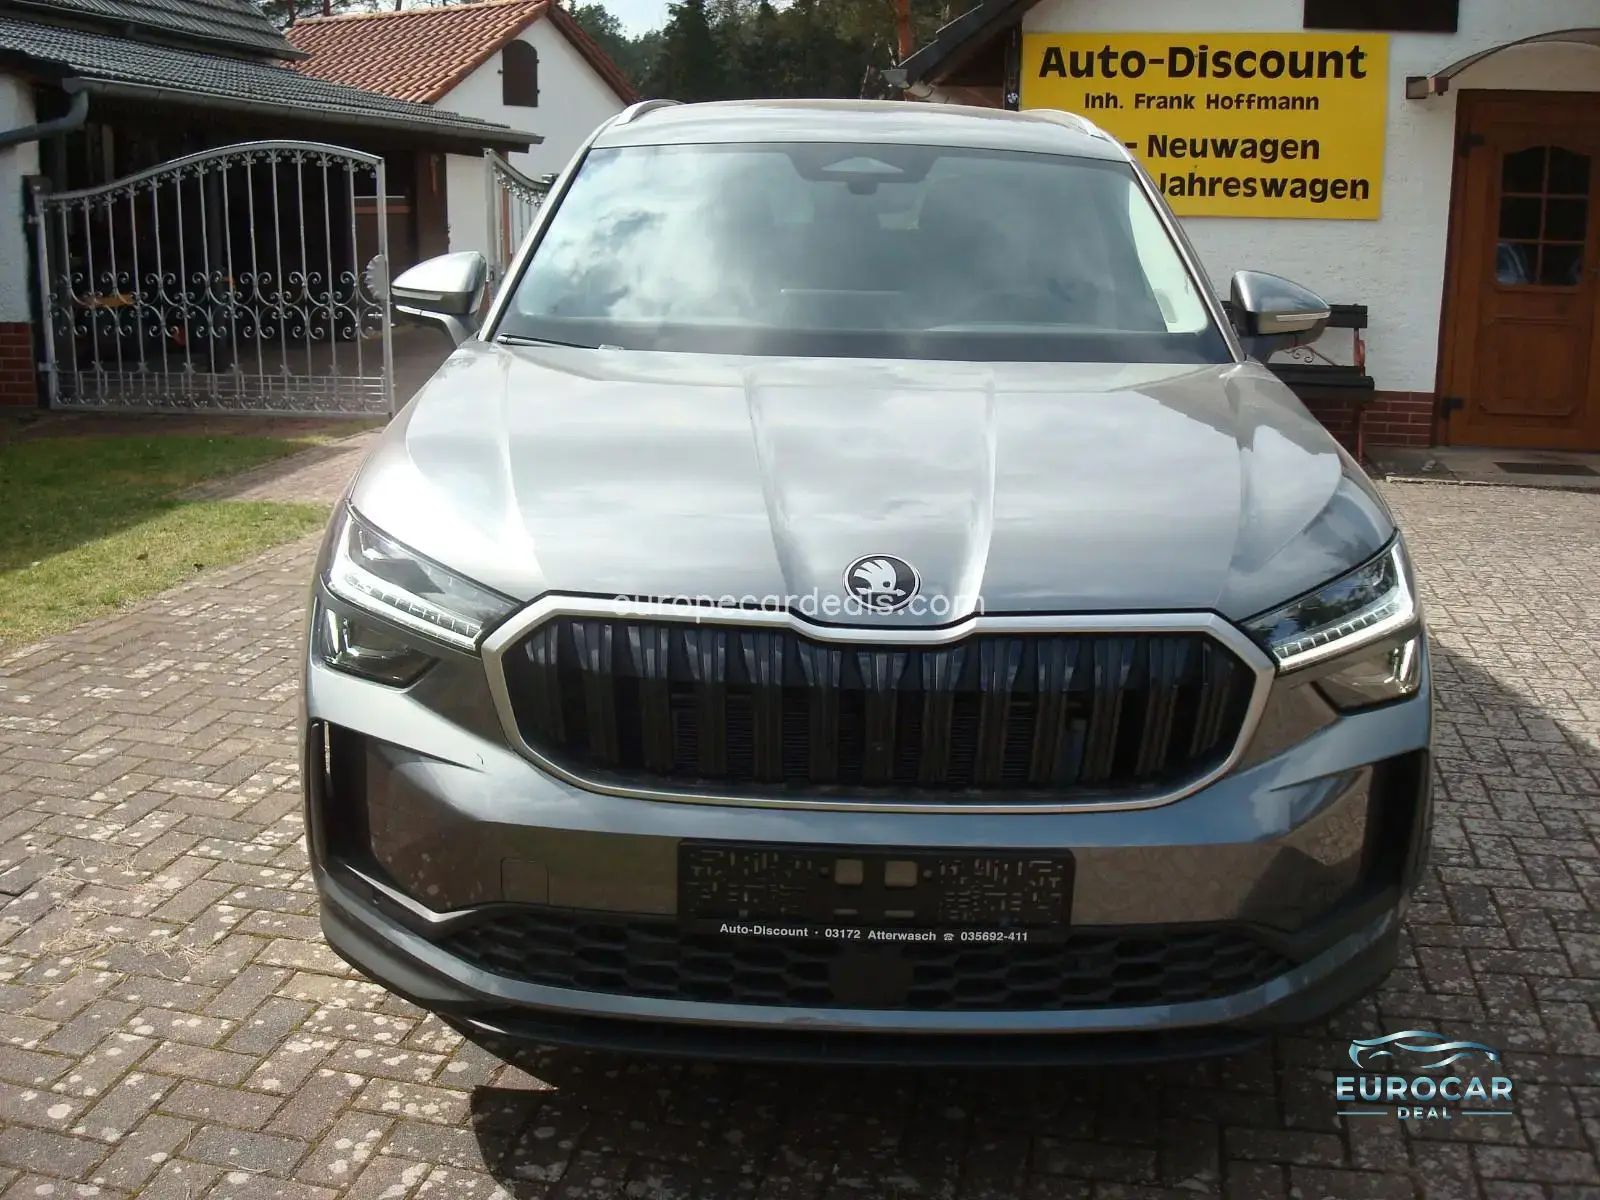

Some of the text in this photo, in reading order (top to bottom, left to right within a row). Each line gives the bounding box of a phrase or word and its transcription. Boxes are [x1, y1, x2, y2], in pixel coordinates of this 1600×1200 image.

[1038, 44, 1367, 79] Auto-Discount
[1084, 92, 1320, 111] Inh. Frank Hoffmann
[1147, 134, 1320, 164] Neuwagen
[1158, 172, 1369, 203] Jahreswagen
[719, 923, 1028, 942] Auto-Discount 03172 Atterwasch 035692-411
